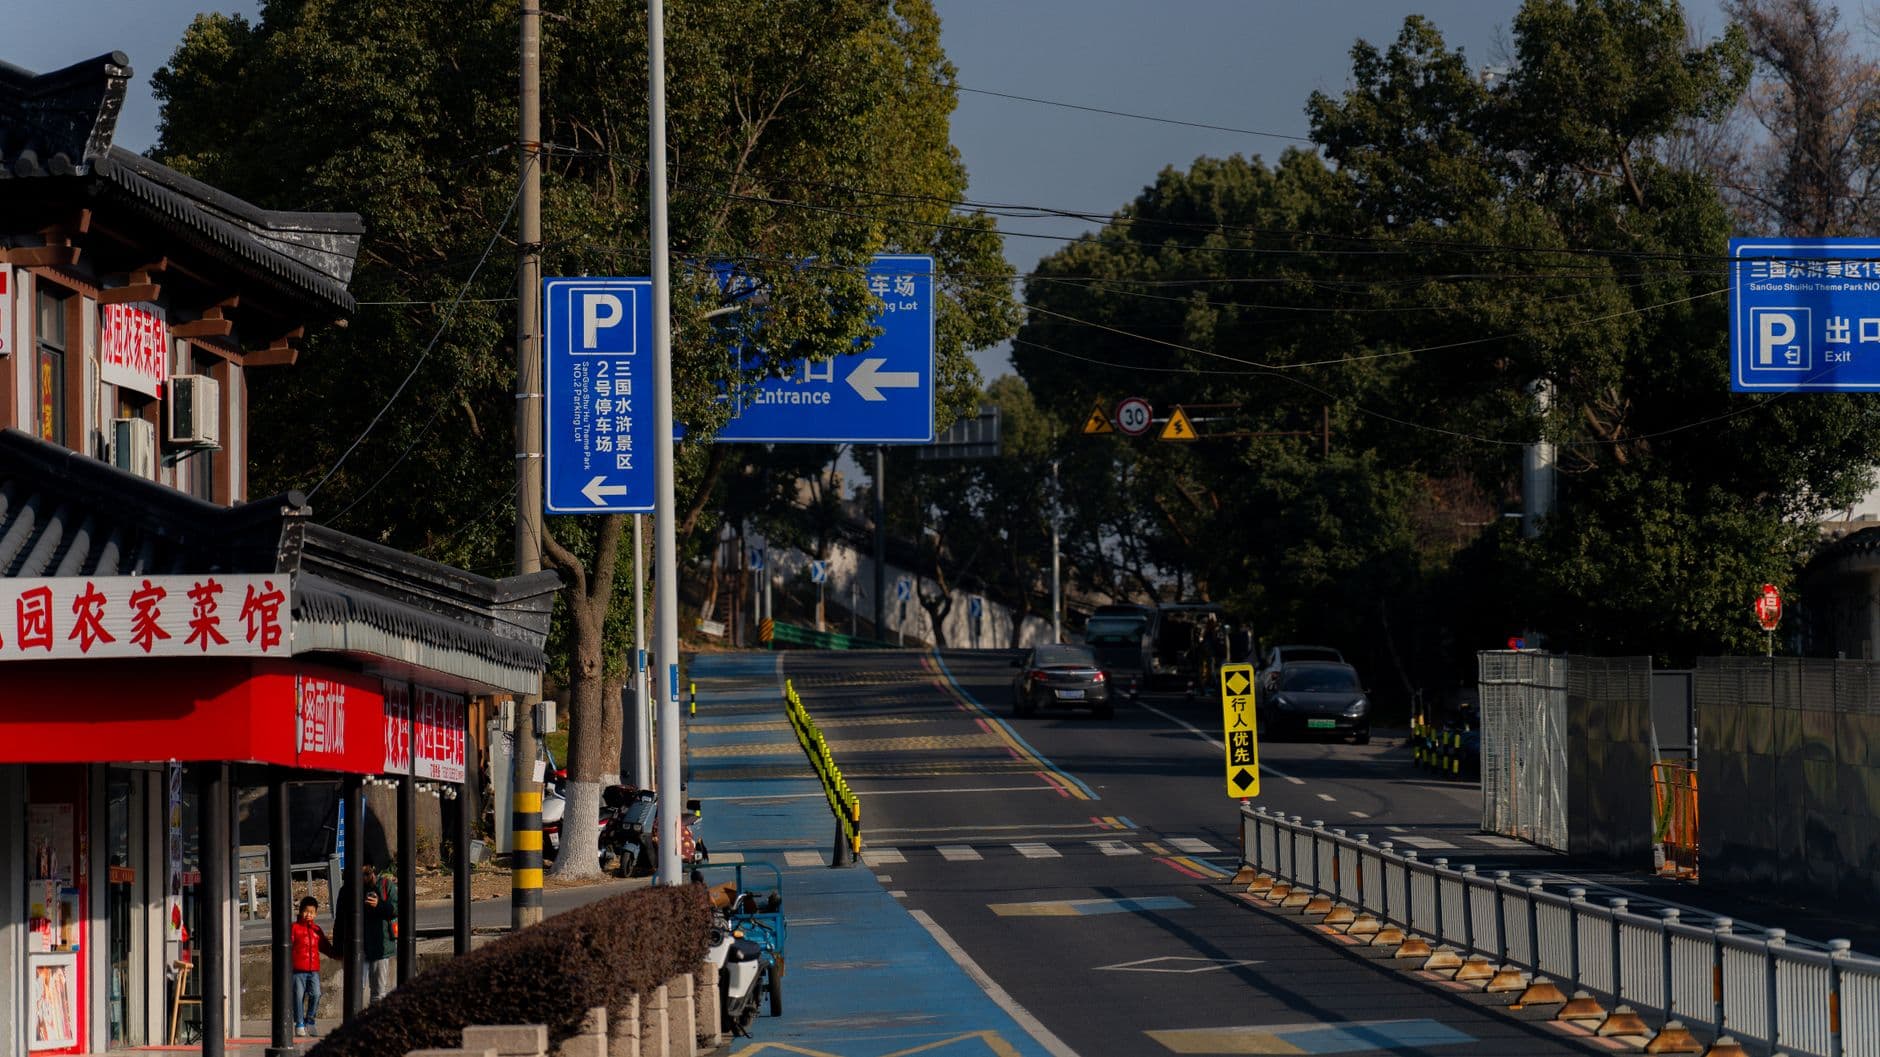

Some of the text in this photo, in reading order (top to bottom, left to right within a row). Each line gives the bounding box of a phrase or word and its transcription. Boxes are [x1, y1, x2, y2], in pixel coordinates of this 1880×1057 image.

[1750, 283, 1783, 291] SanGuo
[1844, 283, 1863, 291] Park
[583, 294, 623, 348] P
[899, 301, 918, 310] Lot
[1760, 313, 1796, 364] P
[1826, 316, 1880, 344] 出口
[1825, 351, 1851, 362] Exit
[573, 389, 582, 425] Parking
[594, 360, 612, 453] 2号停车场
[755, 388, 831, 404] Entrance
[614, 361, 632, 469] 三国水浒景区
[1125, 408, 1144, 426] 30
[583, 424, 591, 451] Theme
[583, 453, 591, 472] Park
[0, 578, 286, 654] 园农家菜馆
[304, 677, 345, 756] 蜜雪冰城
[1231, 697, 1250, 763] 行人优先
